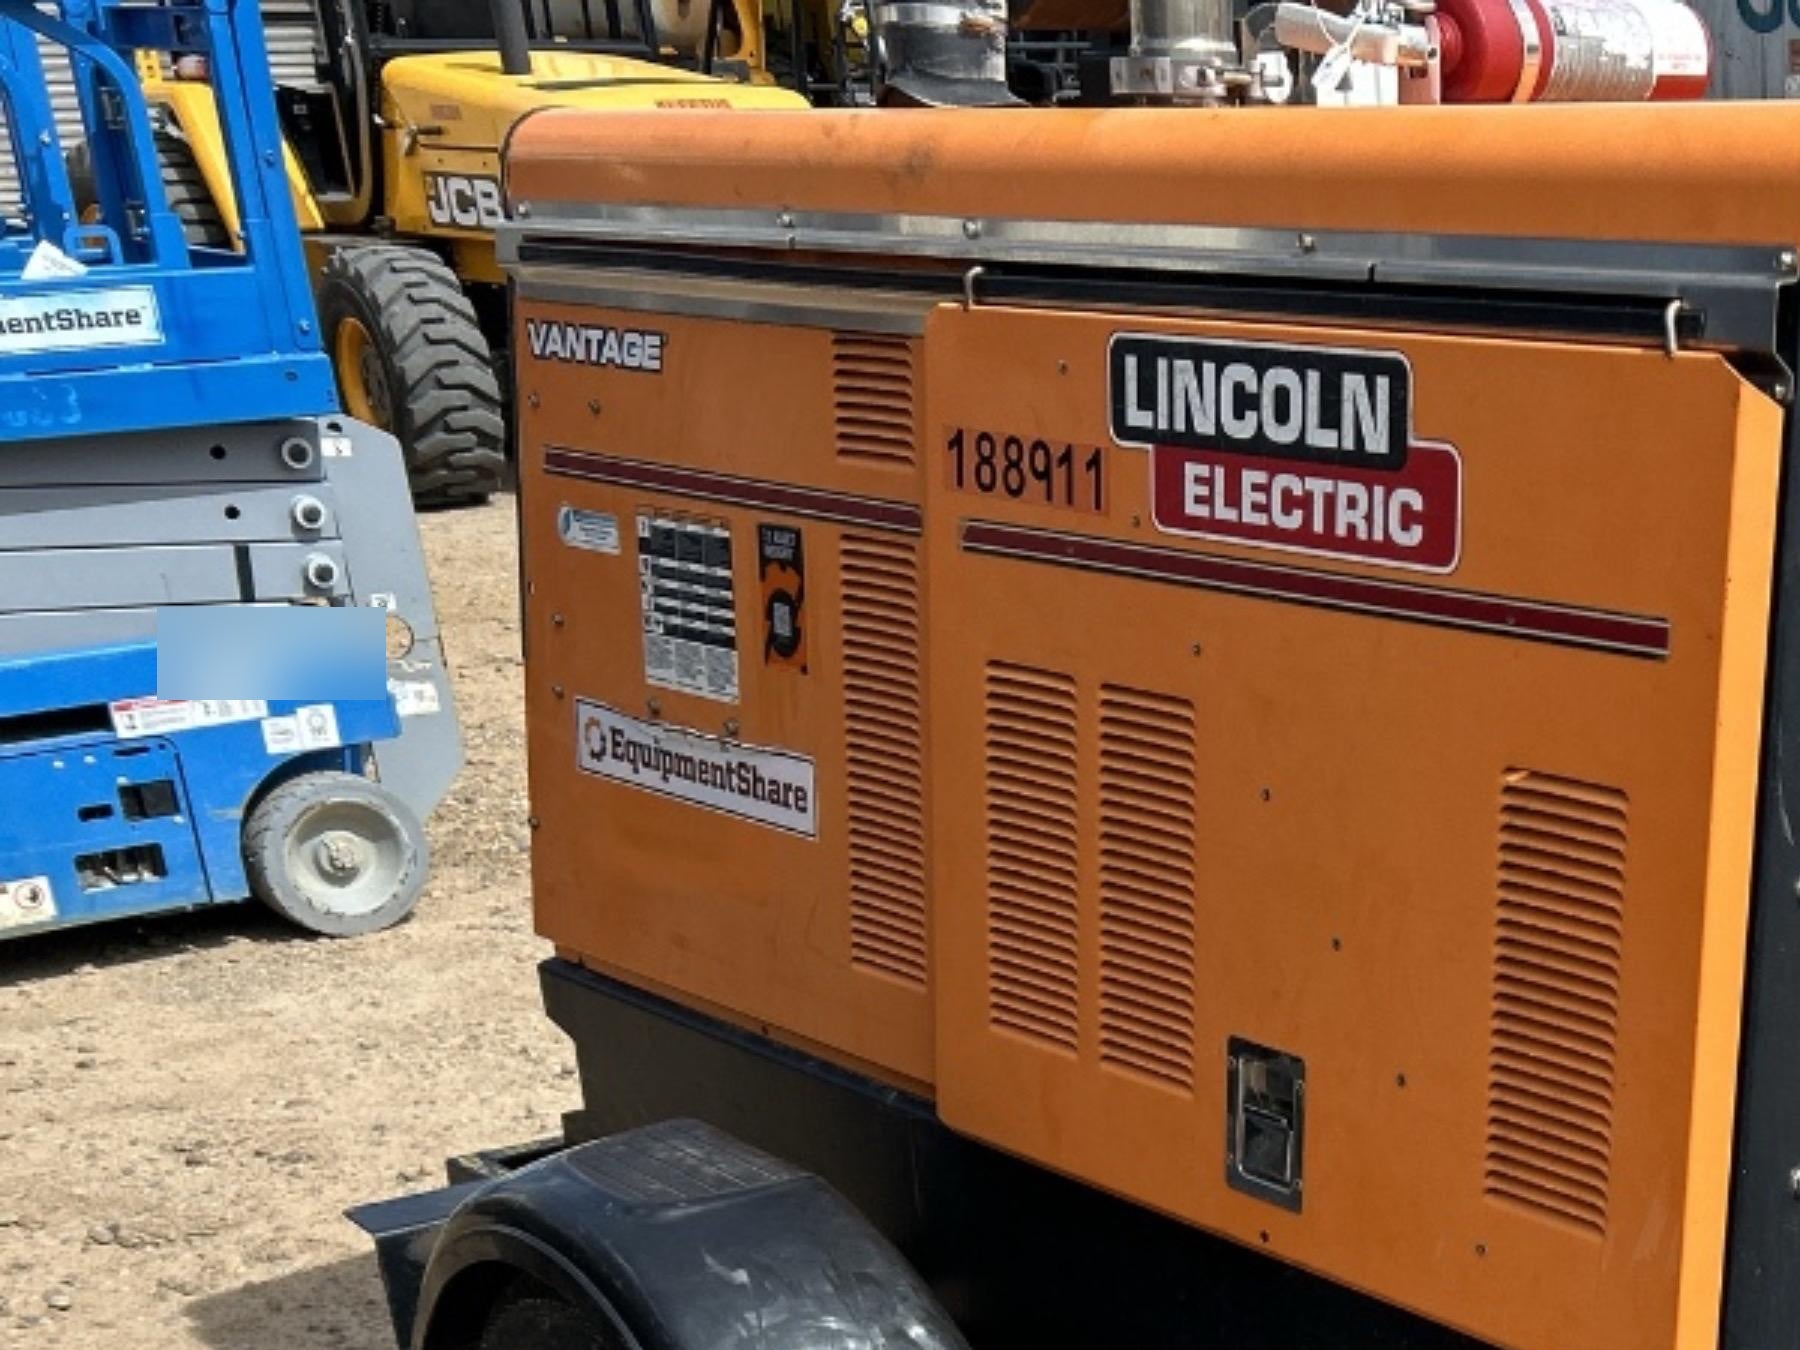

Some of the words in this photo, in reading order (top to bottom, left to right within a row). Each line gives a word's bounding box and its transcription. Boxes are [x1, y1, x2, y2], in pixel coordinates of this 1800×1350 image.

[427, 175, 501, 227] JCB
[527, 321, 662, 370] VANTAGE
[1124, 354, 1391, 455] LINCOLN
[946, 428, 1103, 511] 188911
[1183, 461, 1424, 548] ELECTRIC
[609, 725, 809, 814] EquipmentShare
